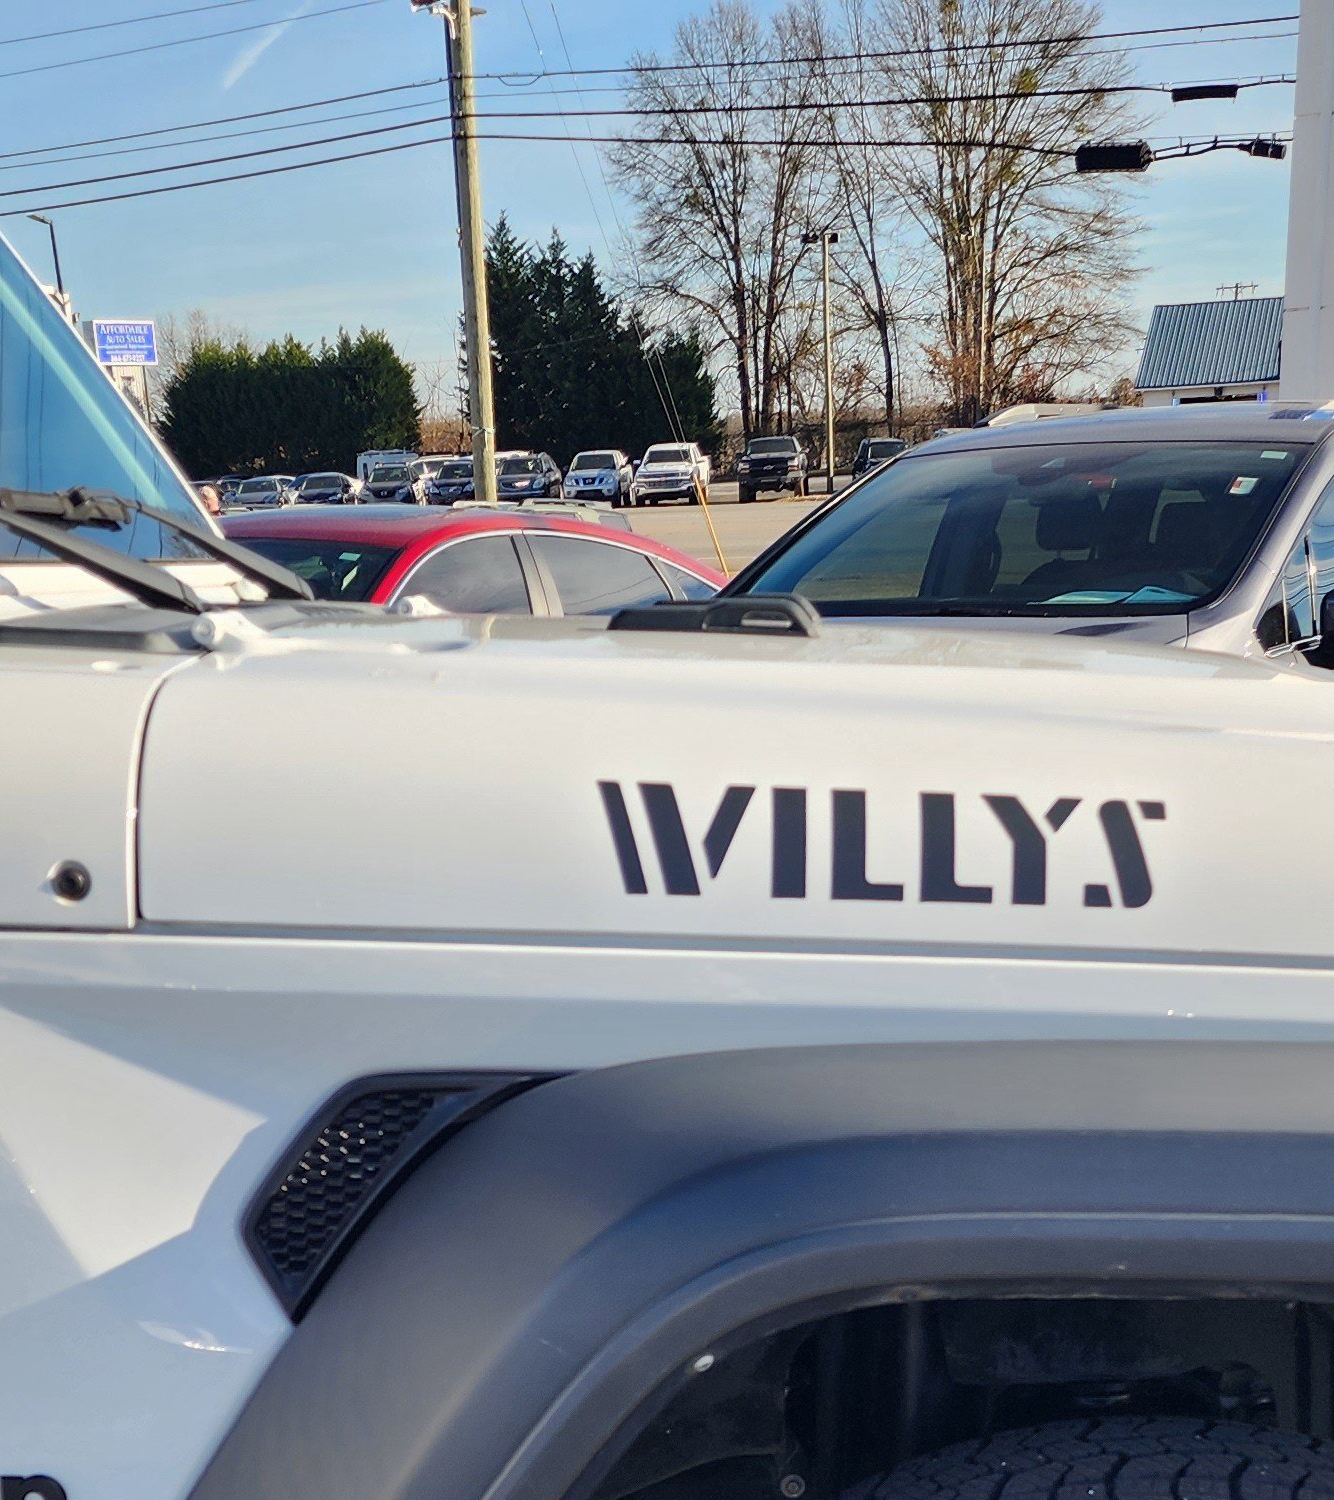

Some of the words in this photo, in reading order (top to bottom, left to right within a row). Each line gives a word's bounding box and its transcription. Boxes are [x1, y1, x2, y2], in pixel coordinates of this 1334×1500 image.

[100, 324, 148, 334] AFFORDABLE
[107, 335, 124, 343] AUTO
[126, 334, 146, 343] SALES
[597, 780, 1167, 908] WILLYS
